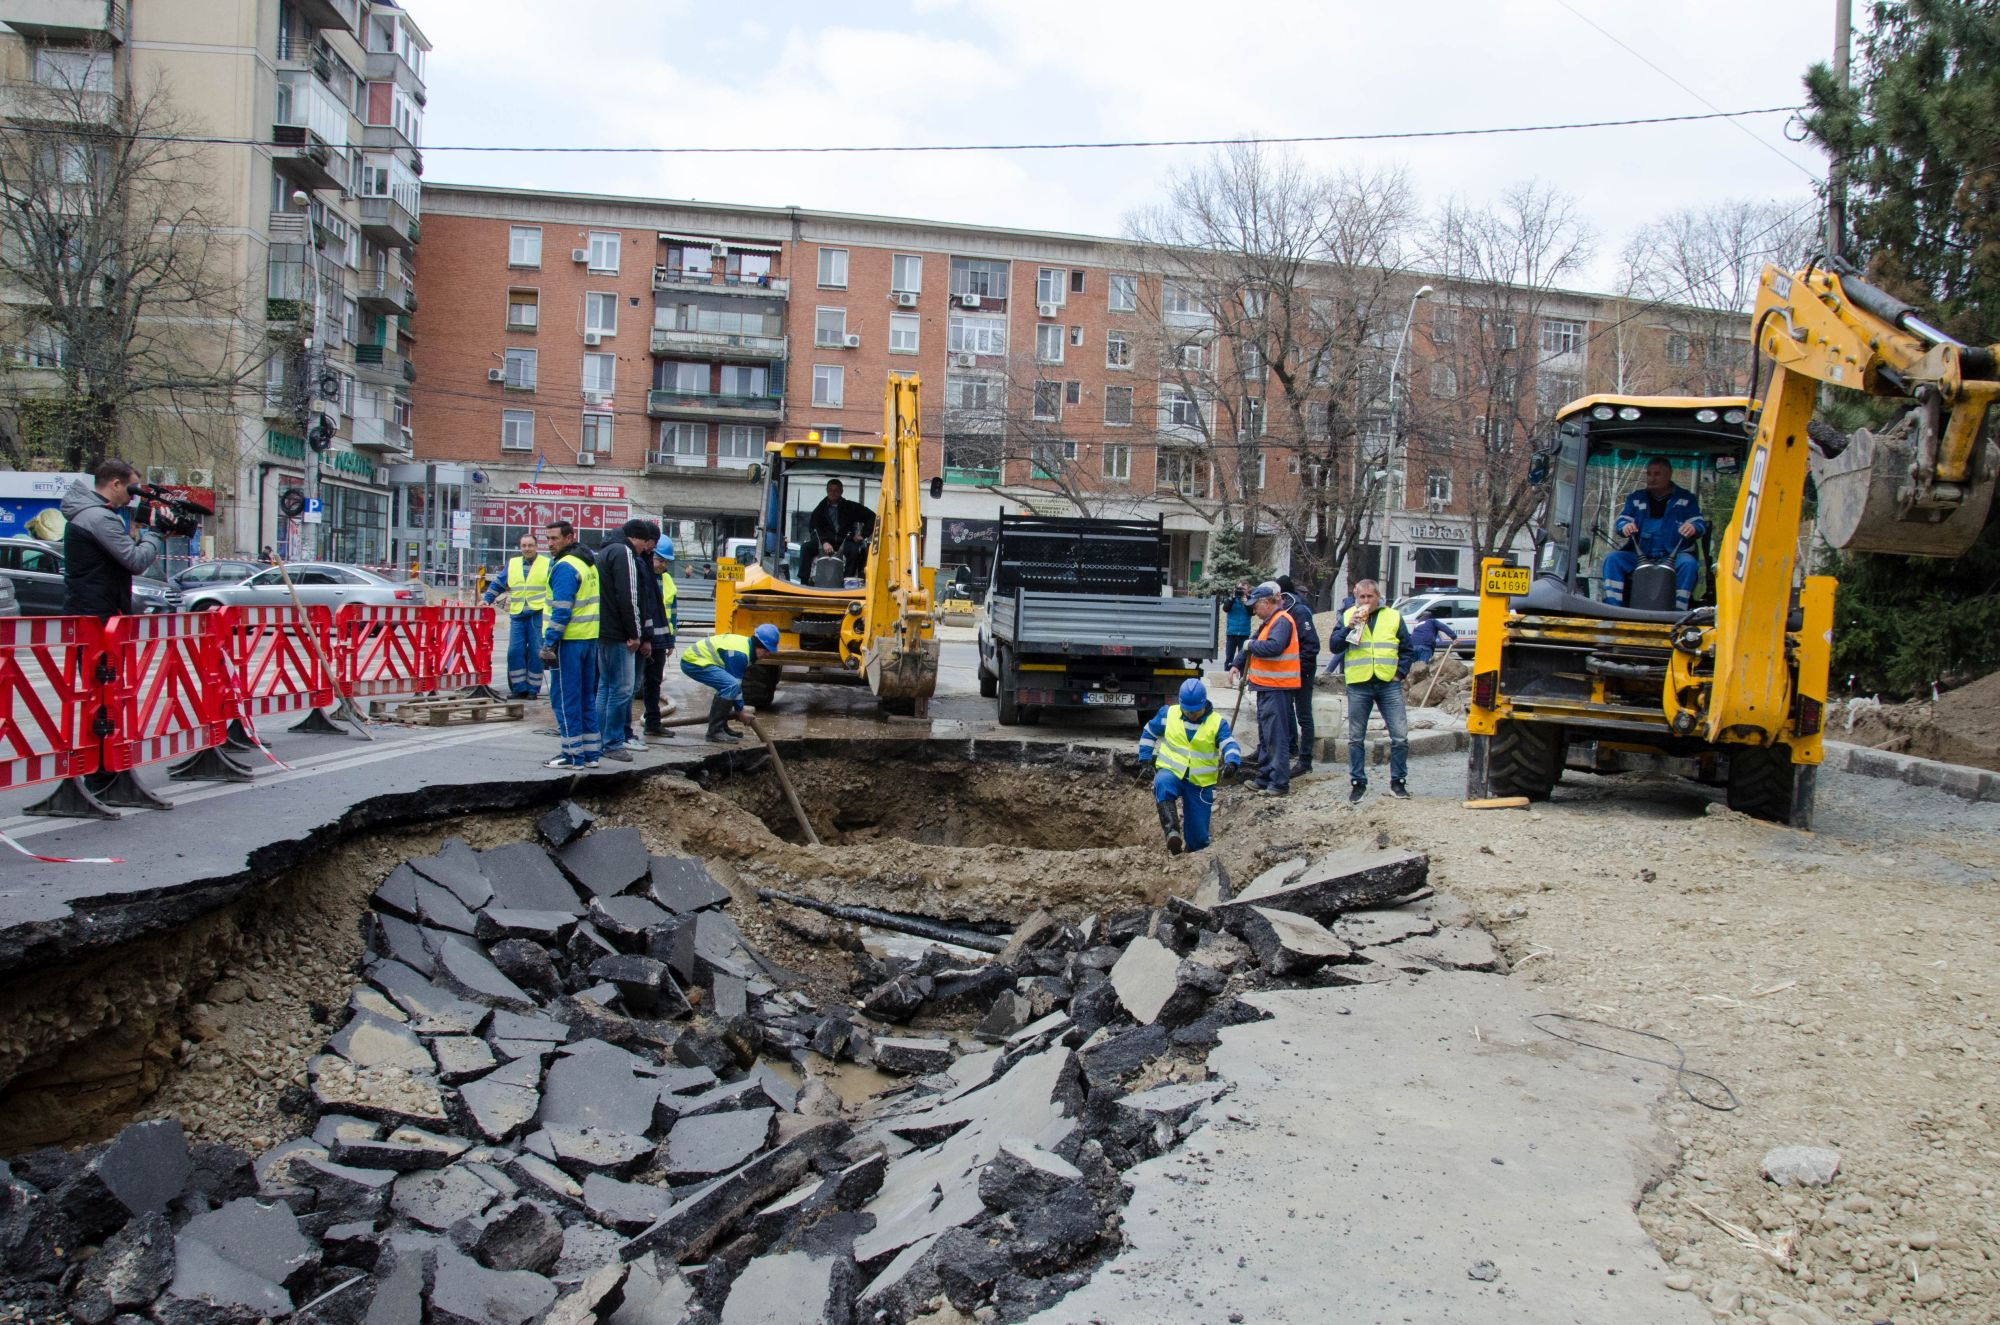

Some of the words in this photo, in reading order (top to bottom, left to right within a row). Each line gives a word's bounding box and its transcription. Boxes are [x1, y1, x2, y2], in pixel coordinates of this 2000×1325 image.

[309, 499, 320, 512] P
[1732, 449, 1766, 580] JCB
[1494, 570, 1529, 579] GALATI
[1488, 580, 1501, 590] GL
[1502, 581, 1527, 591] 1696
[1088, 694, 1100, 702] GL
[1104, 694, 1114, 702] 08
